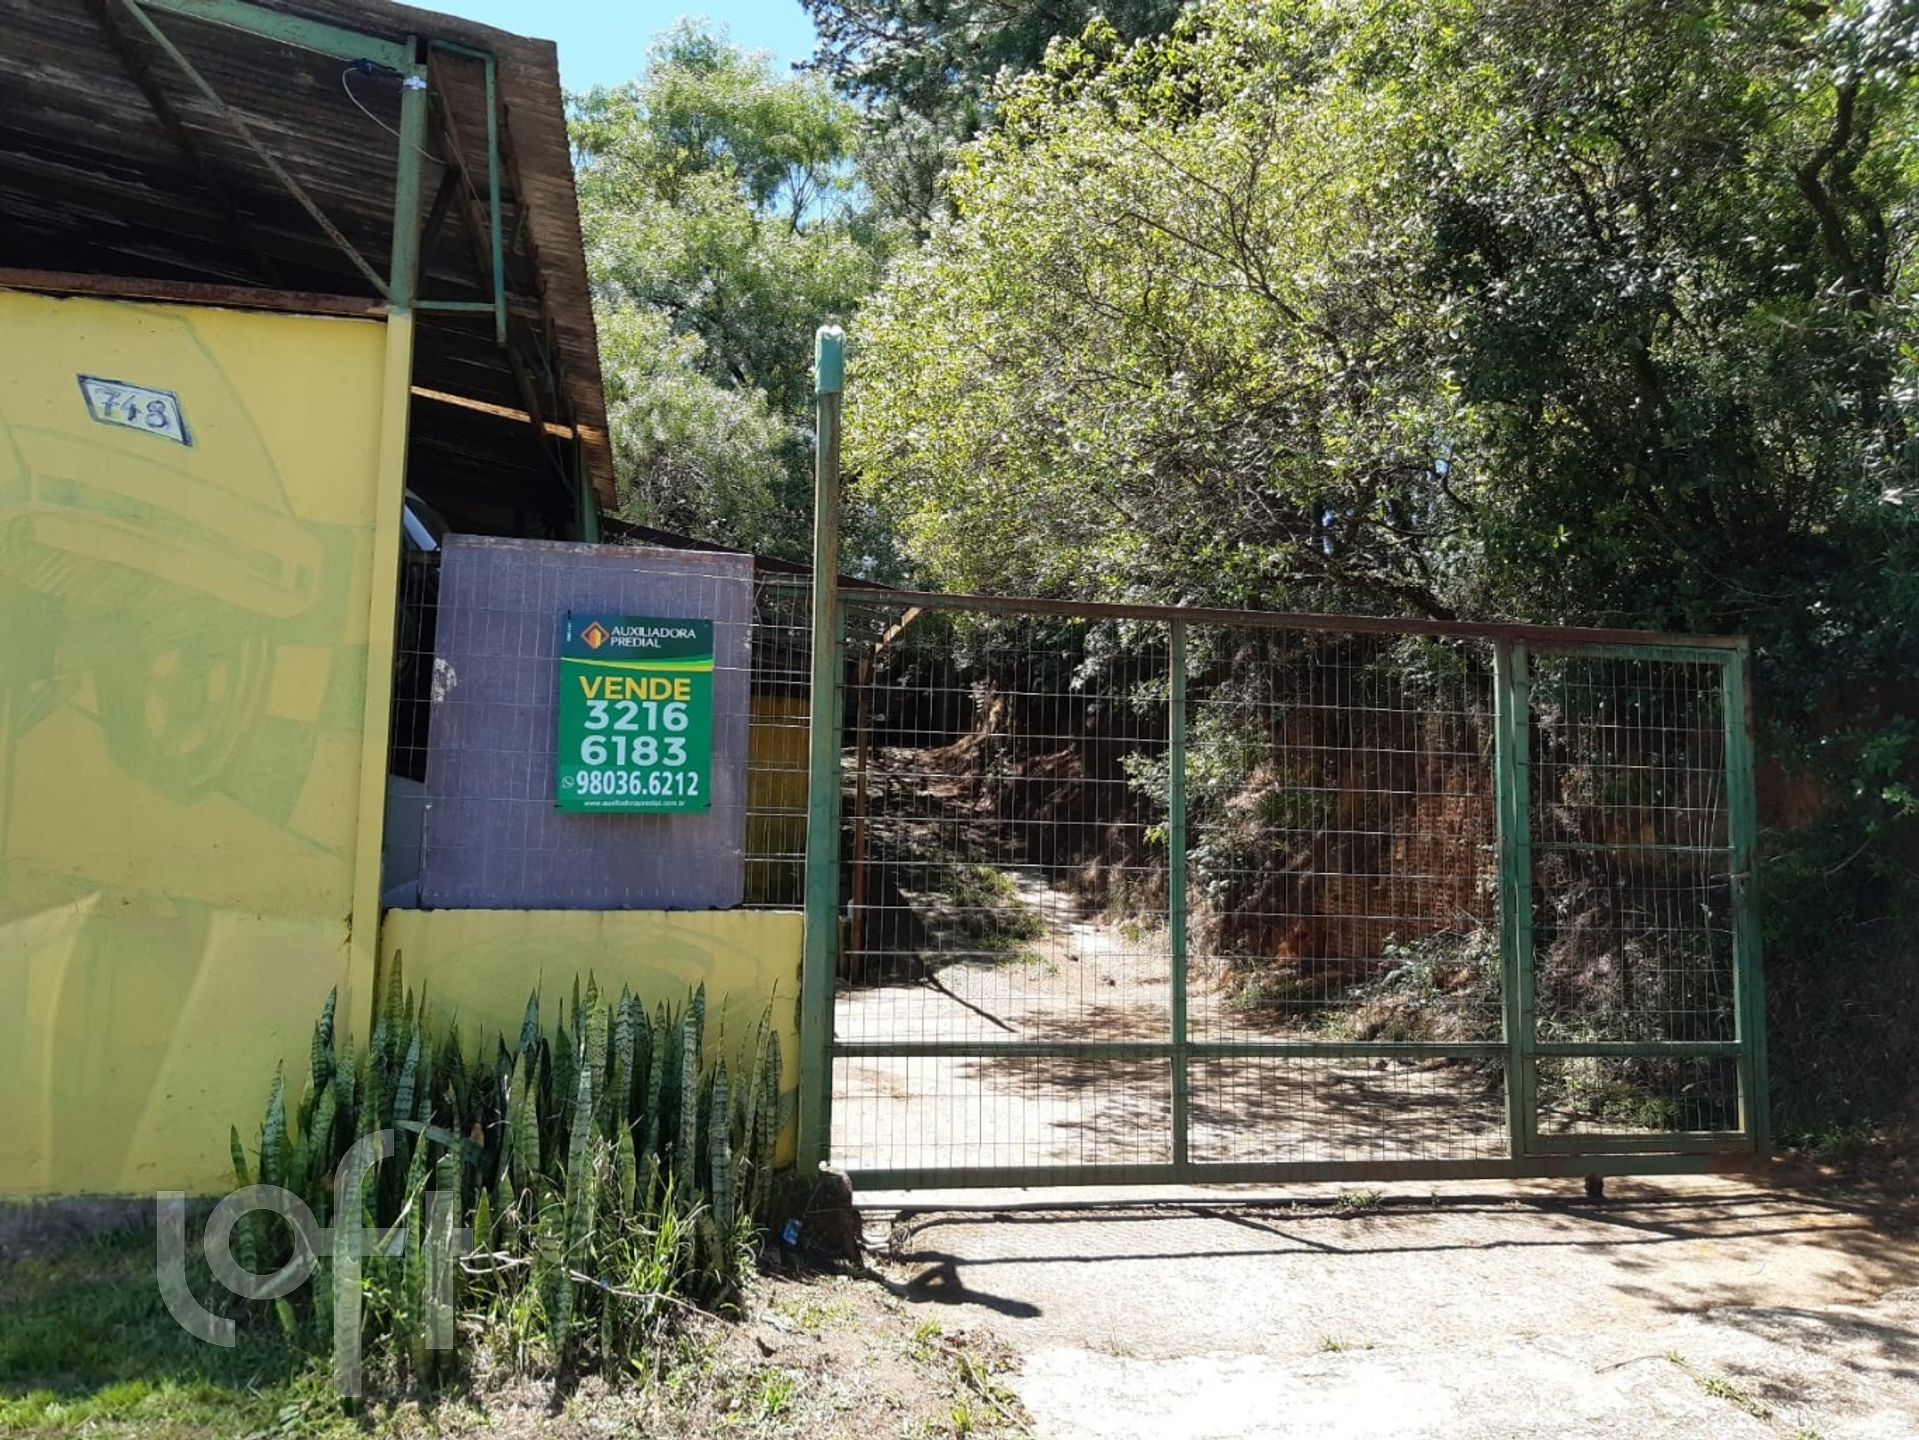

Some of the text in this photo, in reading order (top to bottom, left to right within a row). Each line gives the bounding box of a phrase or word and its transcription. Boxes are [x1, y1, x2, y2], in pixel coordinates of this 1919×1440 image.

[94, 387, 171, 429] 748
[610, 636, 661, 648] PREDIAL
[611, 626, 696, 639] AUXILIADORA
[579, 676, 691, 701] VENDE
[584, 700, 689, 731] 3216
[580, 735, 687, 766] 6183
[576, 770, 699, 796] 98036.6212
